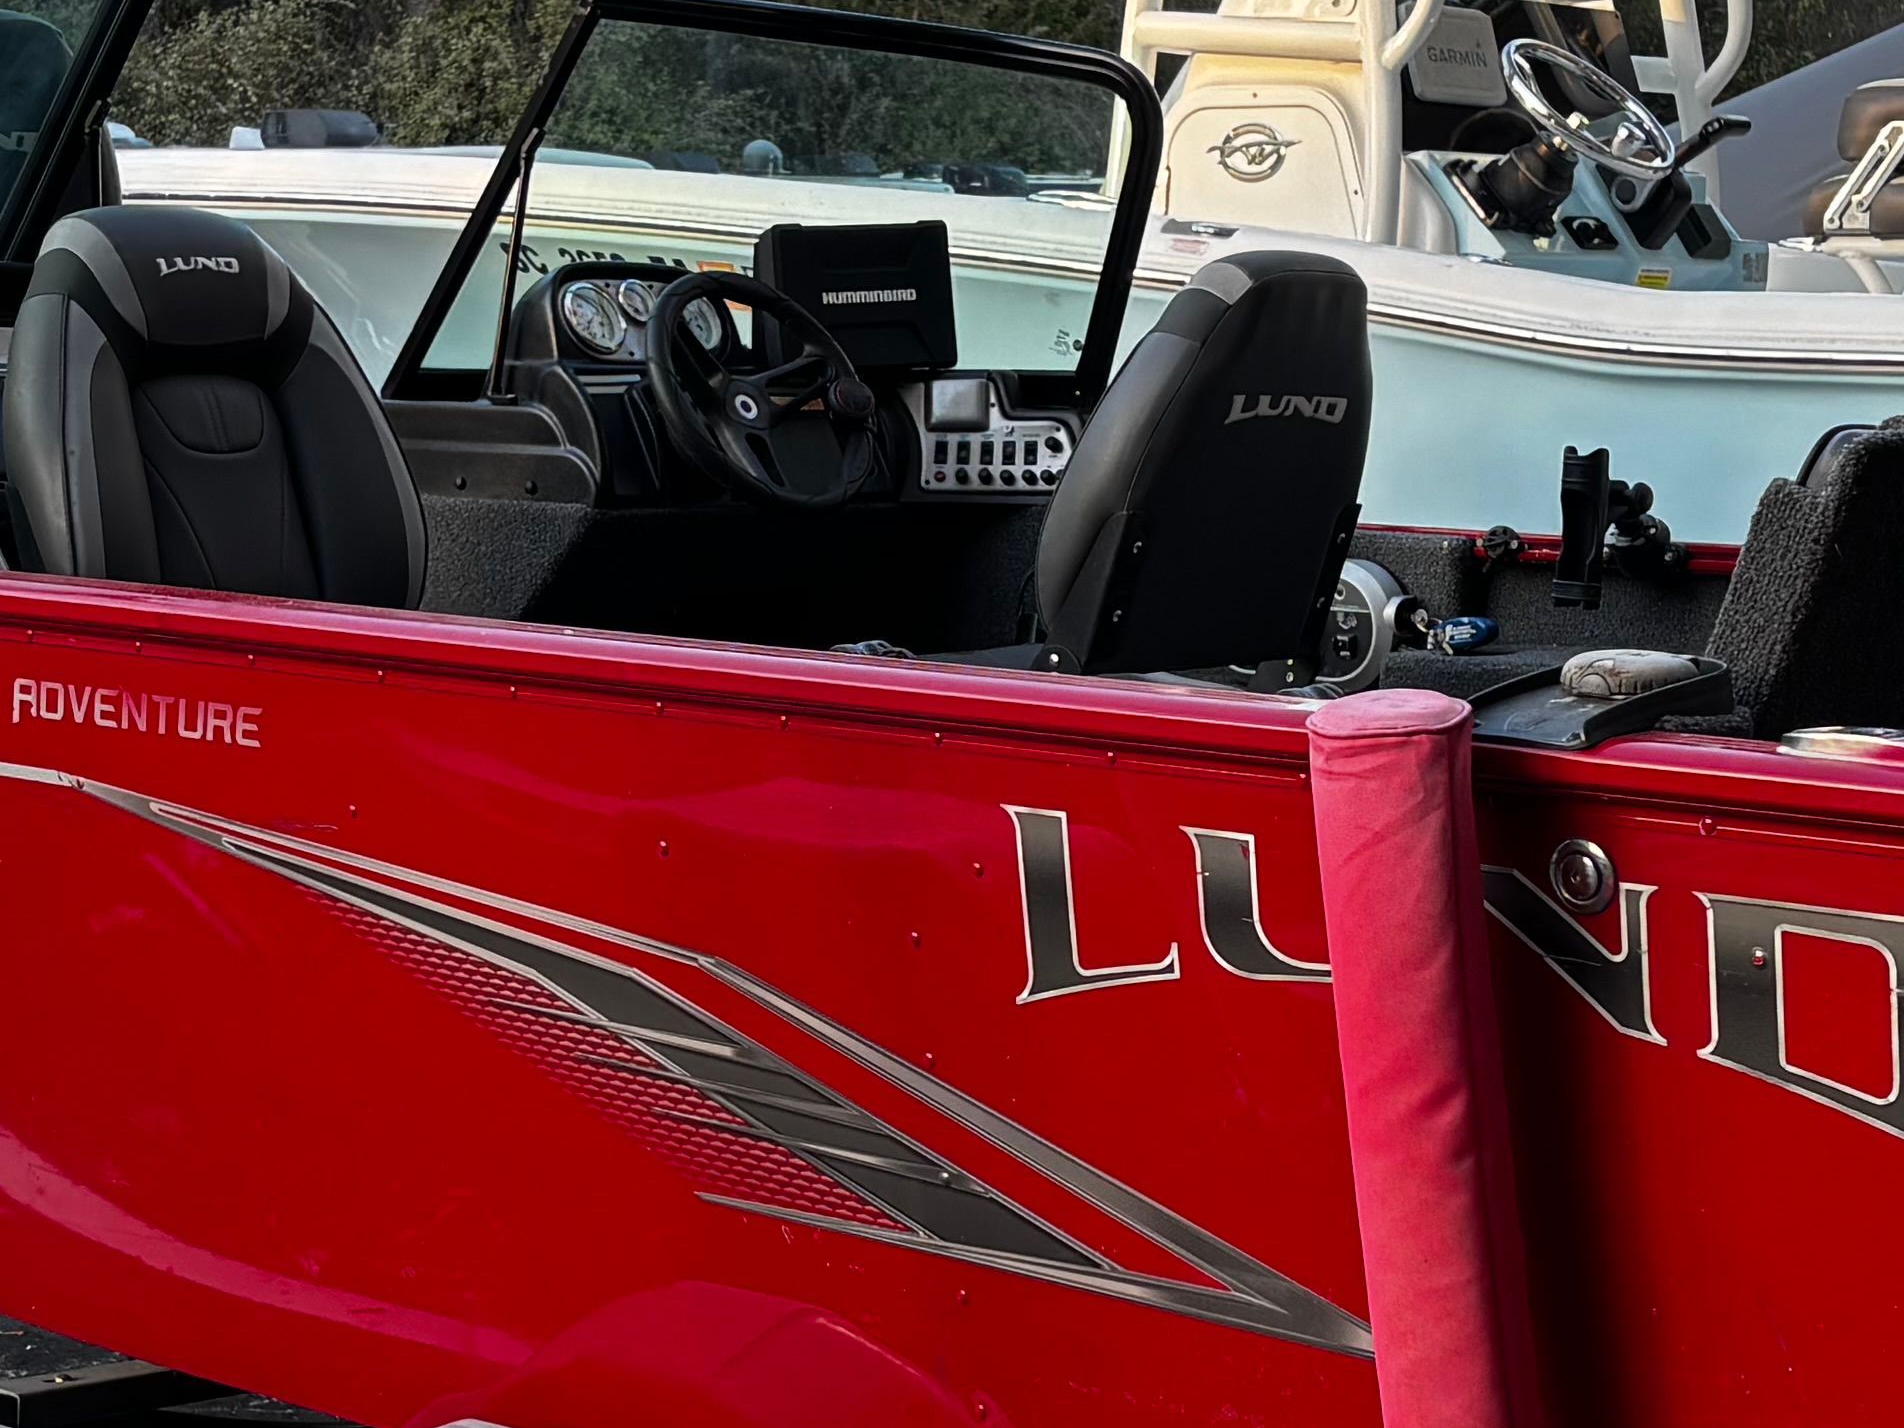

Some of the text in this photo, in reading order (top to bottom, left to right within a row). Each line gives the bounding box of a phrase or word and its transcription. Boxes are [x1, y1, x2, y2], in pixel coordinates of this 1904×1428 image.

[1427, 46, 1487, 69] GARMIN
[156, 256, 240, 277] LUND
[822, 288, 917, 305] HUMMINBIRD
[1223, 394, 1348, 425] LUND
[12, 677, 264, 748] ADVENTURE
